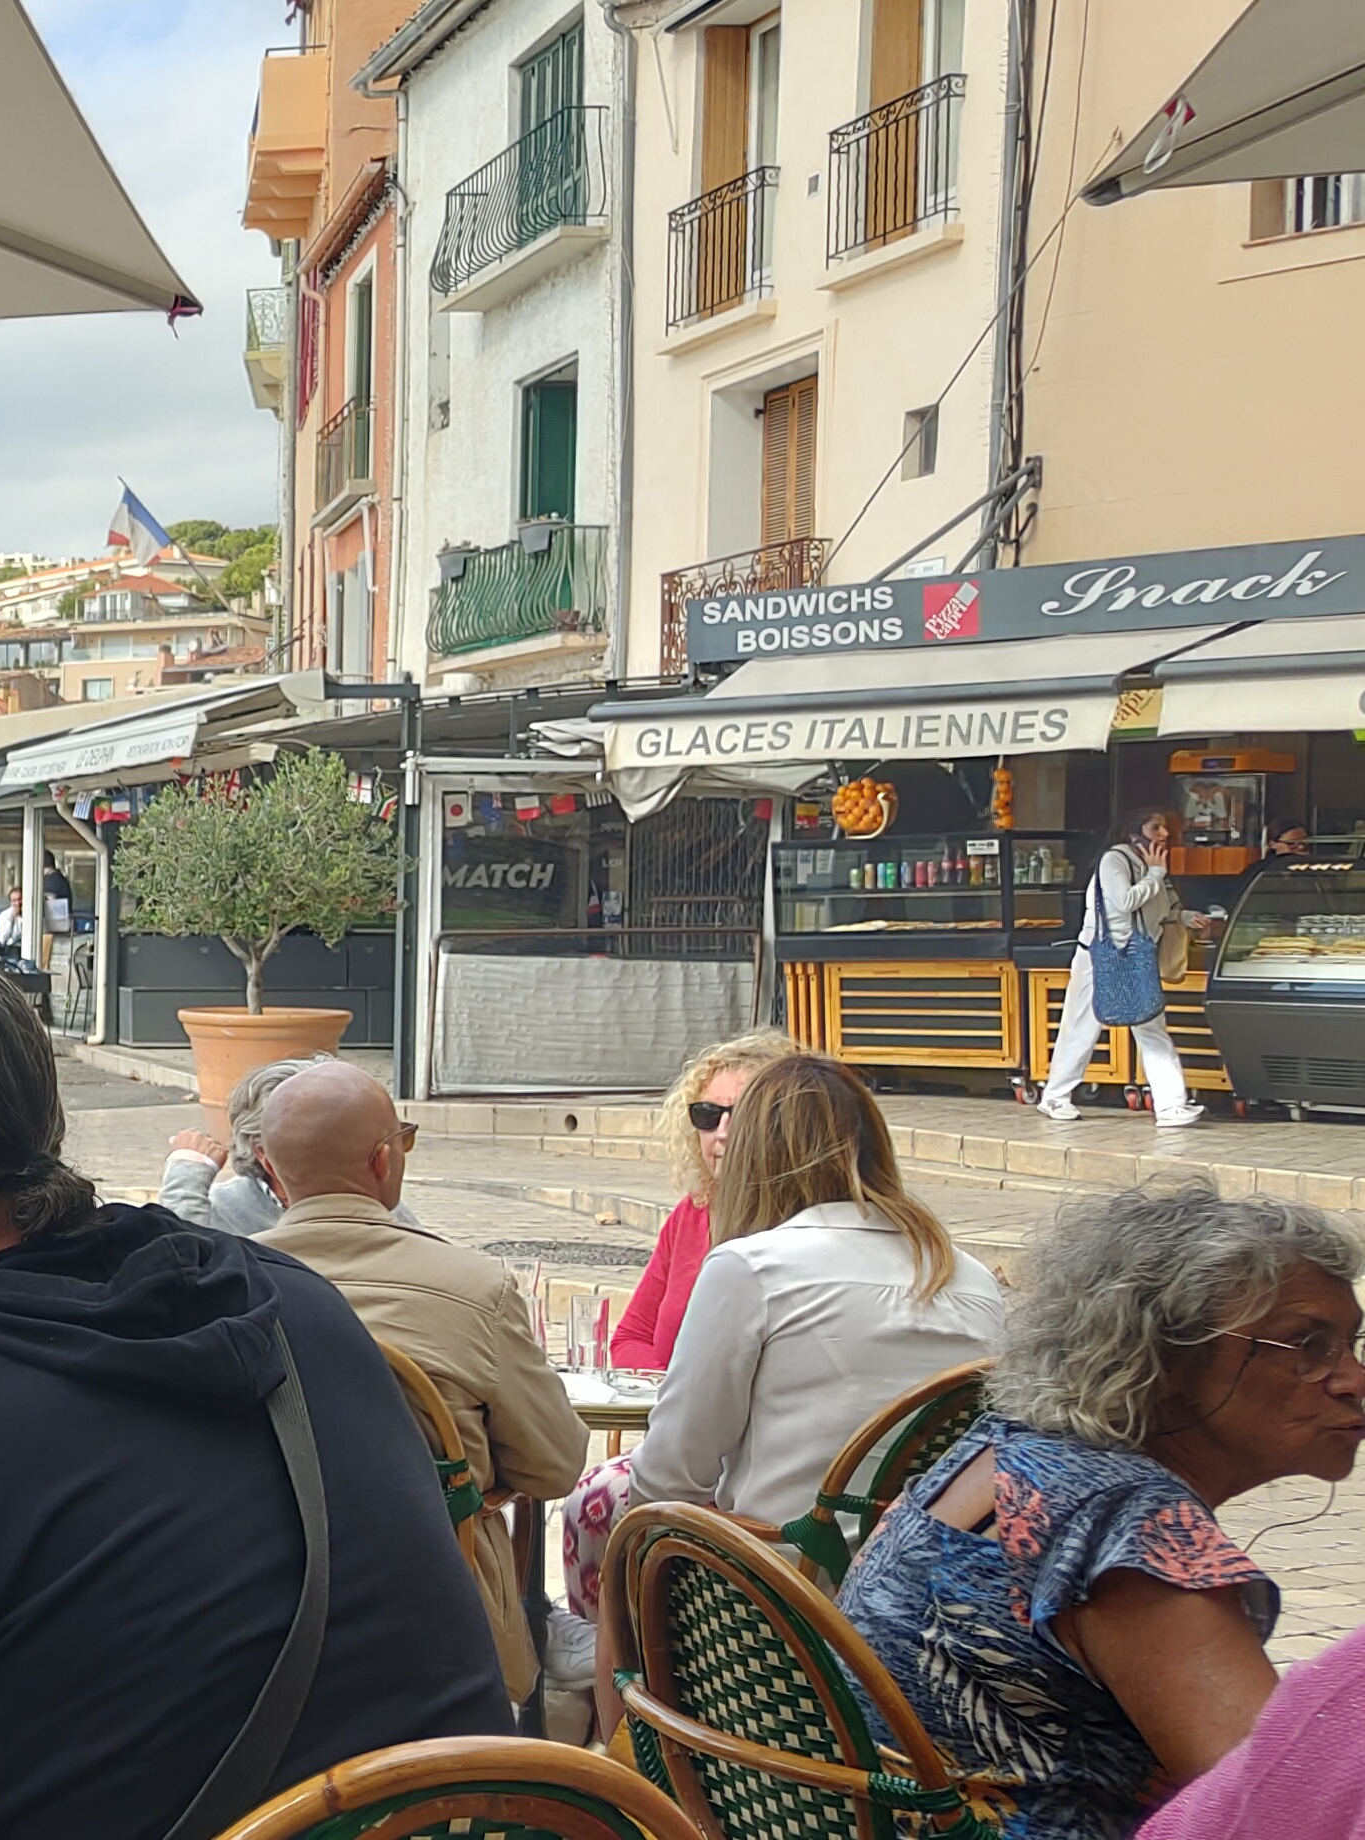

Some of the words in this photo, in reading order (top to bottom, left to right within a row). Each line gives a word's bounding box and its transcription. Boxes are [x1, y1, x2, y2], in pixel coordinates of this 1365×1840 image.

[1041, 551, 1347, 616] Snack
[702, 586, 894, 625] SANDWICHS
[925, 597, 961, 635] Pizza
[737, 618, 903, 653] BOISSONS
[636, 721, 793, 758] GLACES
[804, 708, 1069, 750] ITALIENNES
[443, 863, 555, 889] MATCH
